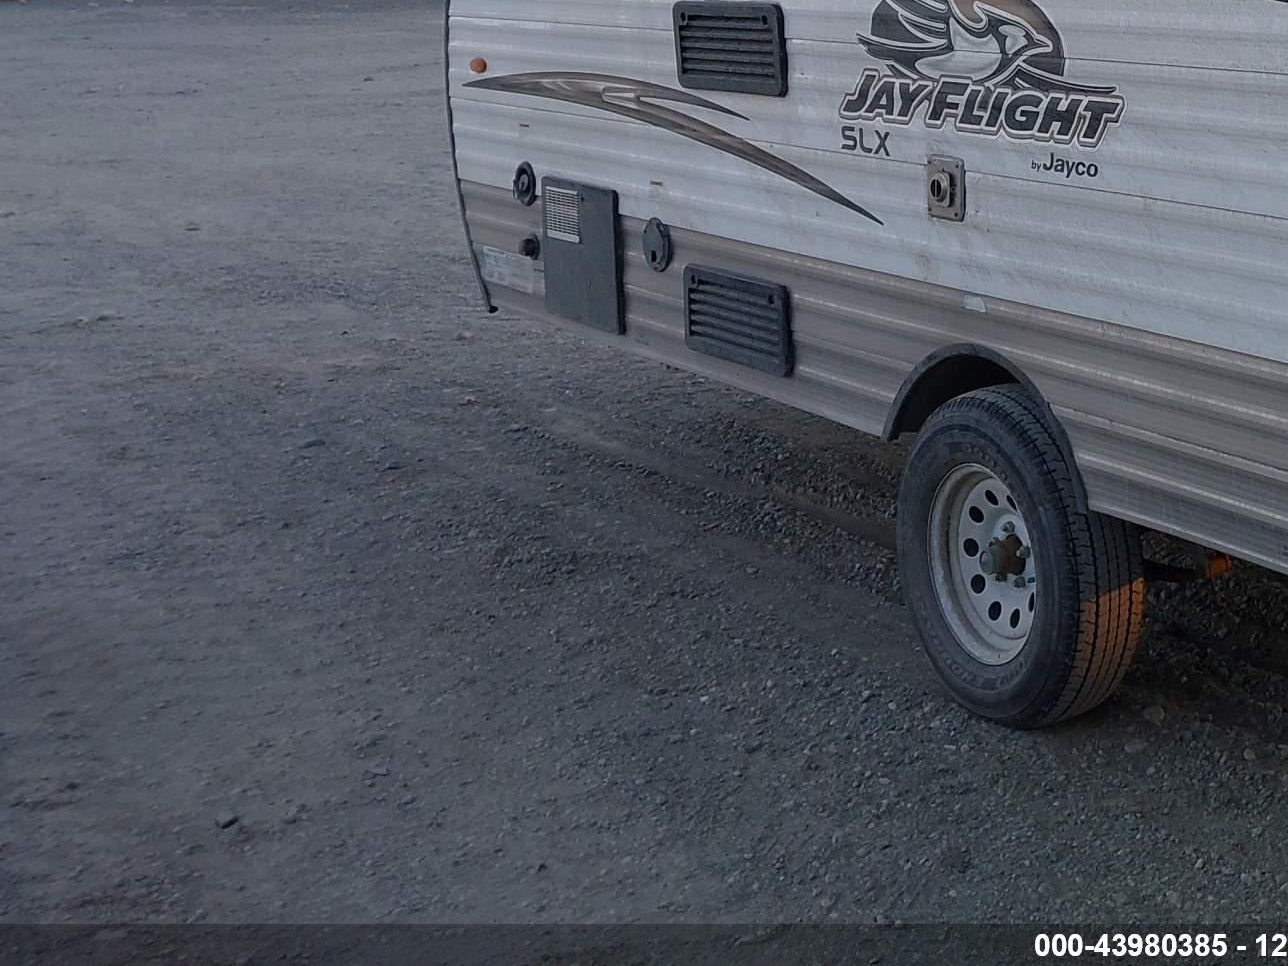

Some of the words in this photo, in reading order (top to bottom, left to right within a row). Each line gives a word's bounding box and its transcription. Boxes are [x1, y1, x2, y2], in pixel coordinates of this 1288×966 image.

[841, 126, 891, 156] SLX
[1031, 160, 1041, 172] by
[1043, 152, 1099, 178] Jayco
